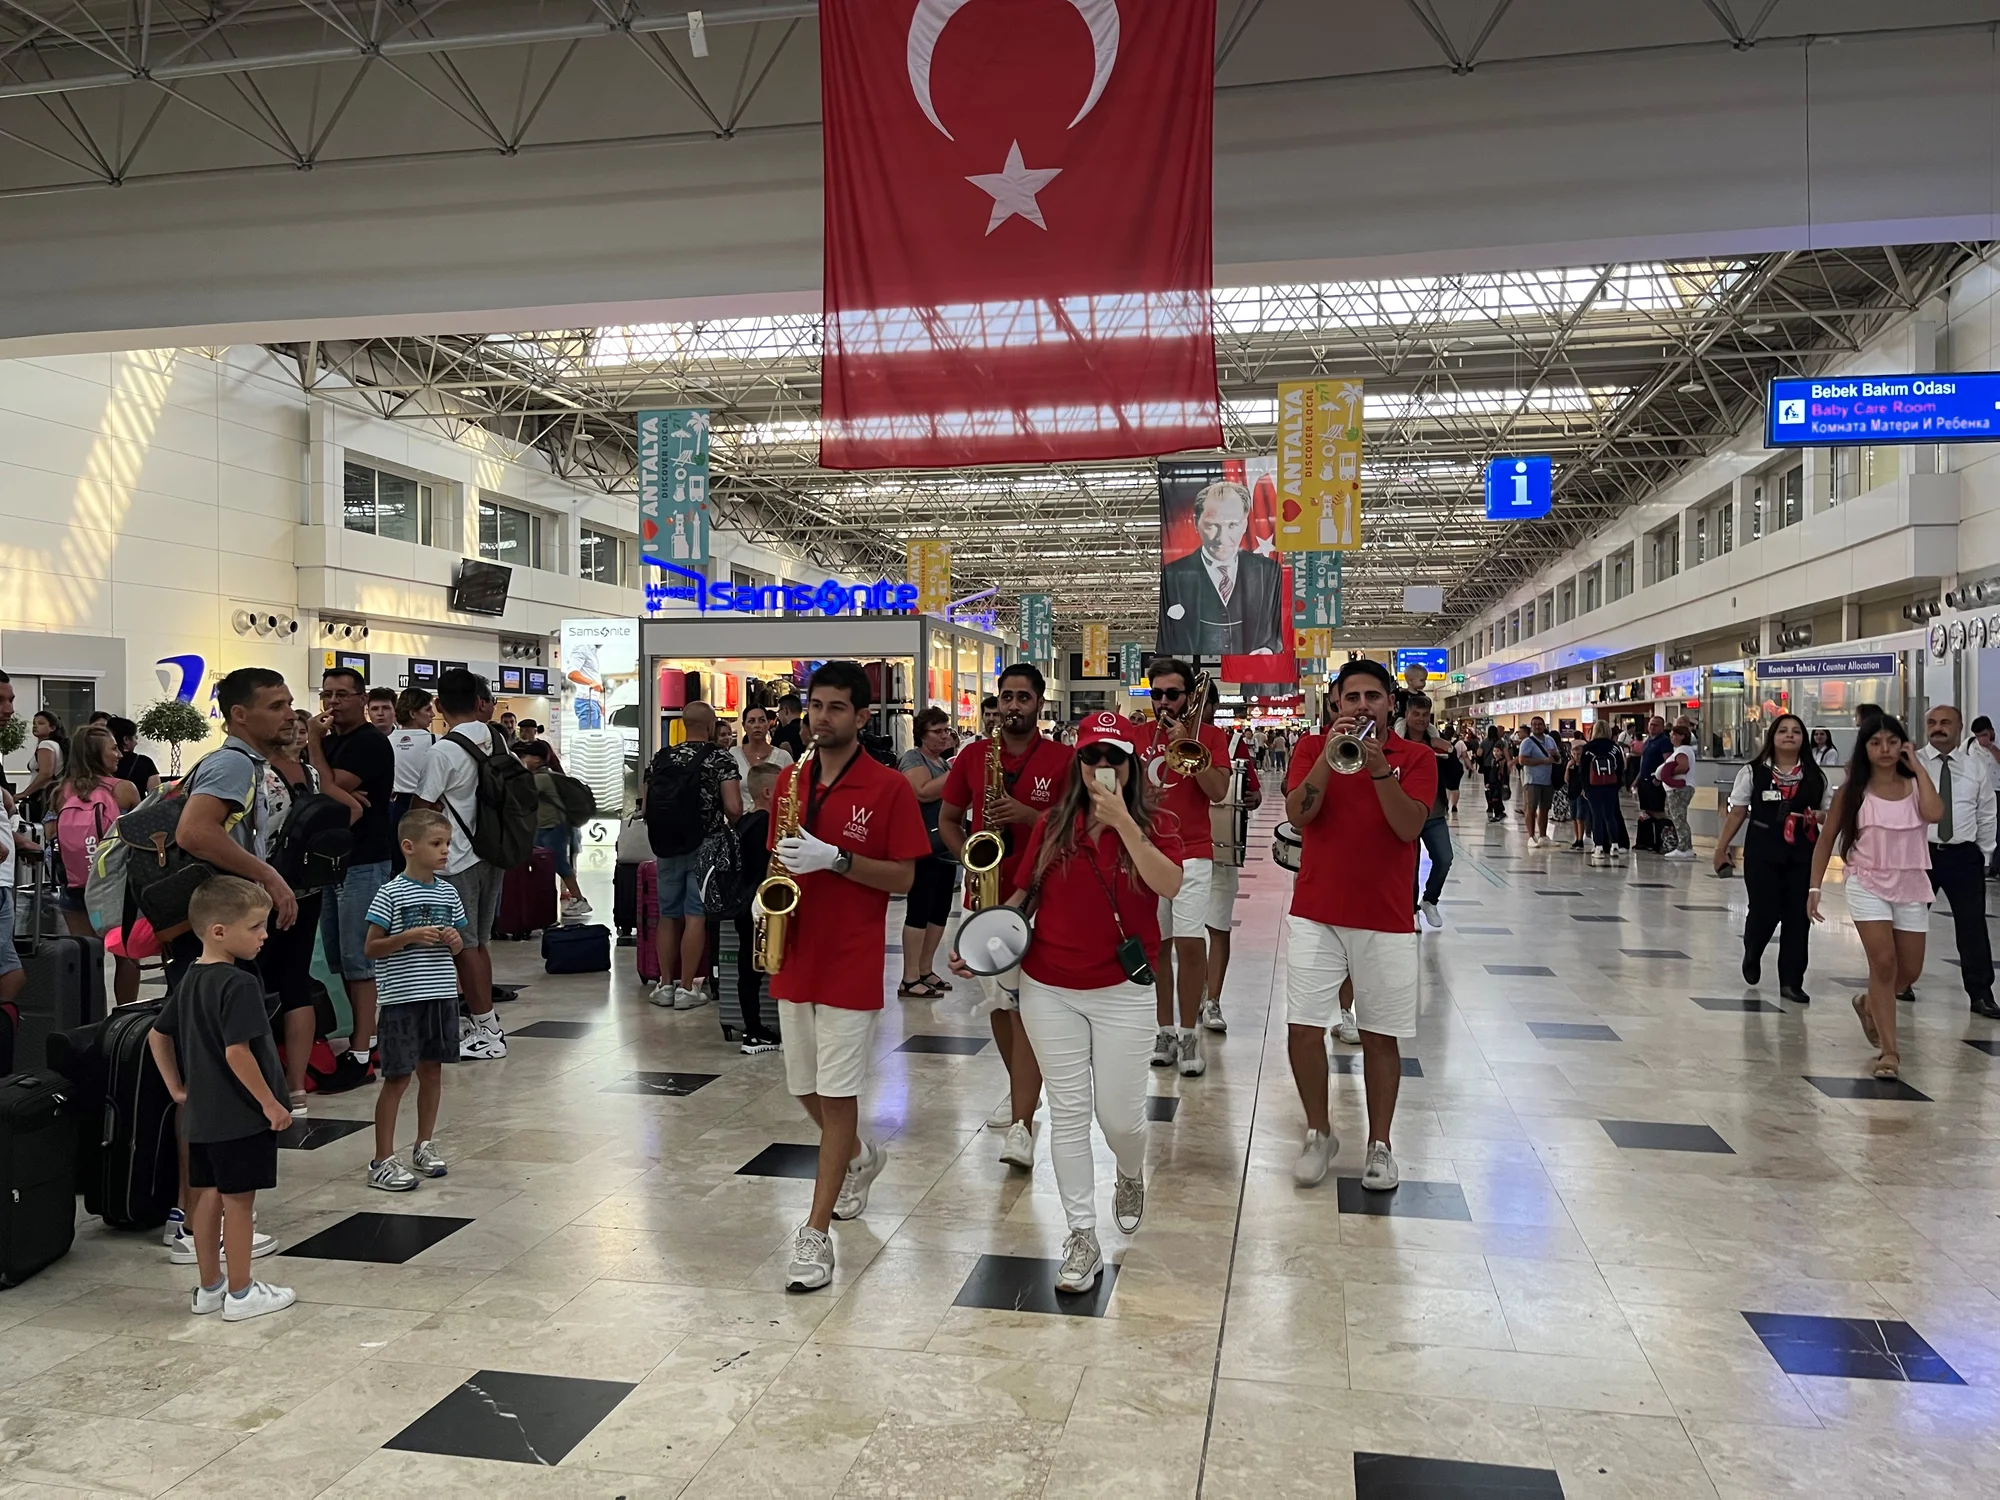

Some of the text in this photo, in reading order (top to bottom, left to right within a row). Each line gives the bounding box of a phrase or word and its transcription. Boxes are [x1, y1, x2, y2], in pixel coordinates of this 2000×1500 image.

[1812, 381, 1956, 398] Bebek Bakım Odası
[1811, 401, 1936, 419] Baby Care Room
[1812, 416, 1990, 434] Комната Матери И Ребенка
[1305, 388, 1314, 478] DISCOVER LOCAL
[1282, 389, 1303, 534] I ANTALYA
[642, 417, 658, 552] I ANTALYA
[645, 583, 696, 598] House
[1768, 665, 1794, 674] Kontuar
[1796, 664, 1816, 672] Tahsis
[1822, 662, 1846, 671] Counter
[1848, 661, 1880, 670] Allocation
[400, 676, 409, 687] 117
[1267, 707, 1294, 717] Arby's
[1093, 727, 1121, 736] TÜRKİYE
[1031, 789, 1050, 797] ADEN
[844, 821, 869, 836] ADEN
